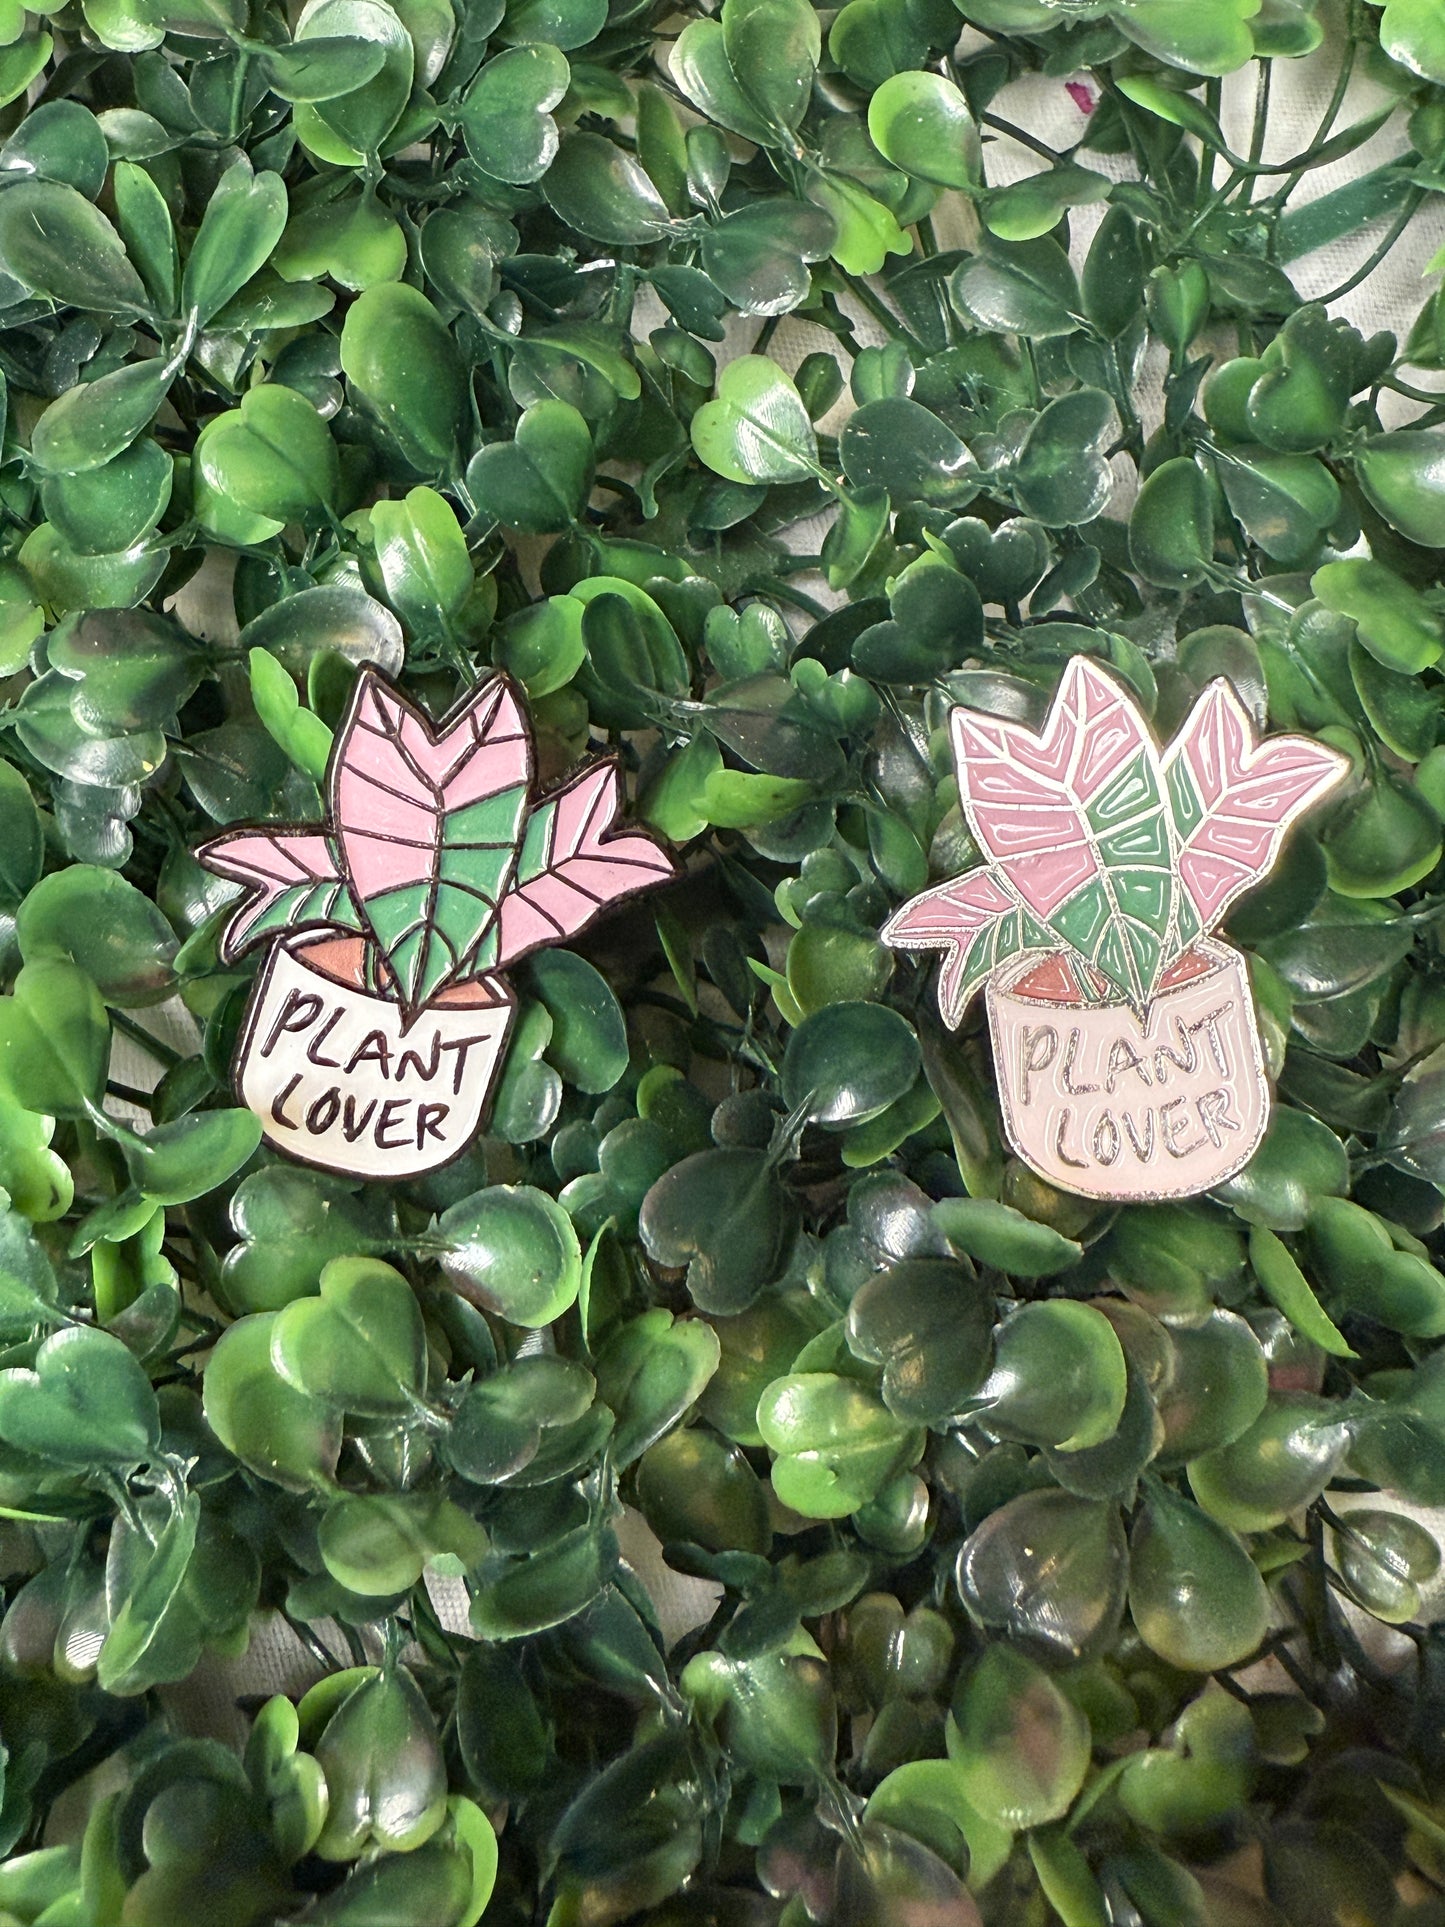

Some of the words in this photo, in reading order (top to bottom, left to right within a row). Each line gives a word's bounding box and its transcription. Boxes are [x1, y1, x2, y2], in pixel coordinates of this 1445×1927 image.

[261, 987, 491, 1095] PLANT
[1019, 1000, 1234, 1106] PLANT
[271, 1073, 450, 1151] LOVER
[1056, 1088, 1241, 1169] LOVER
